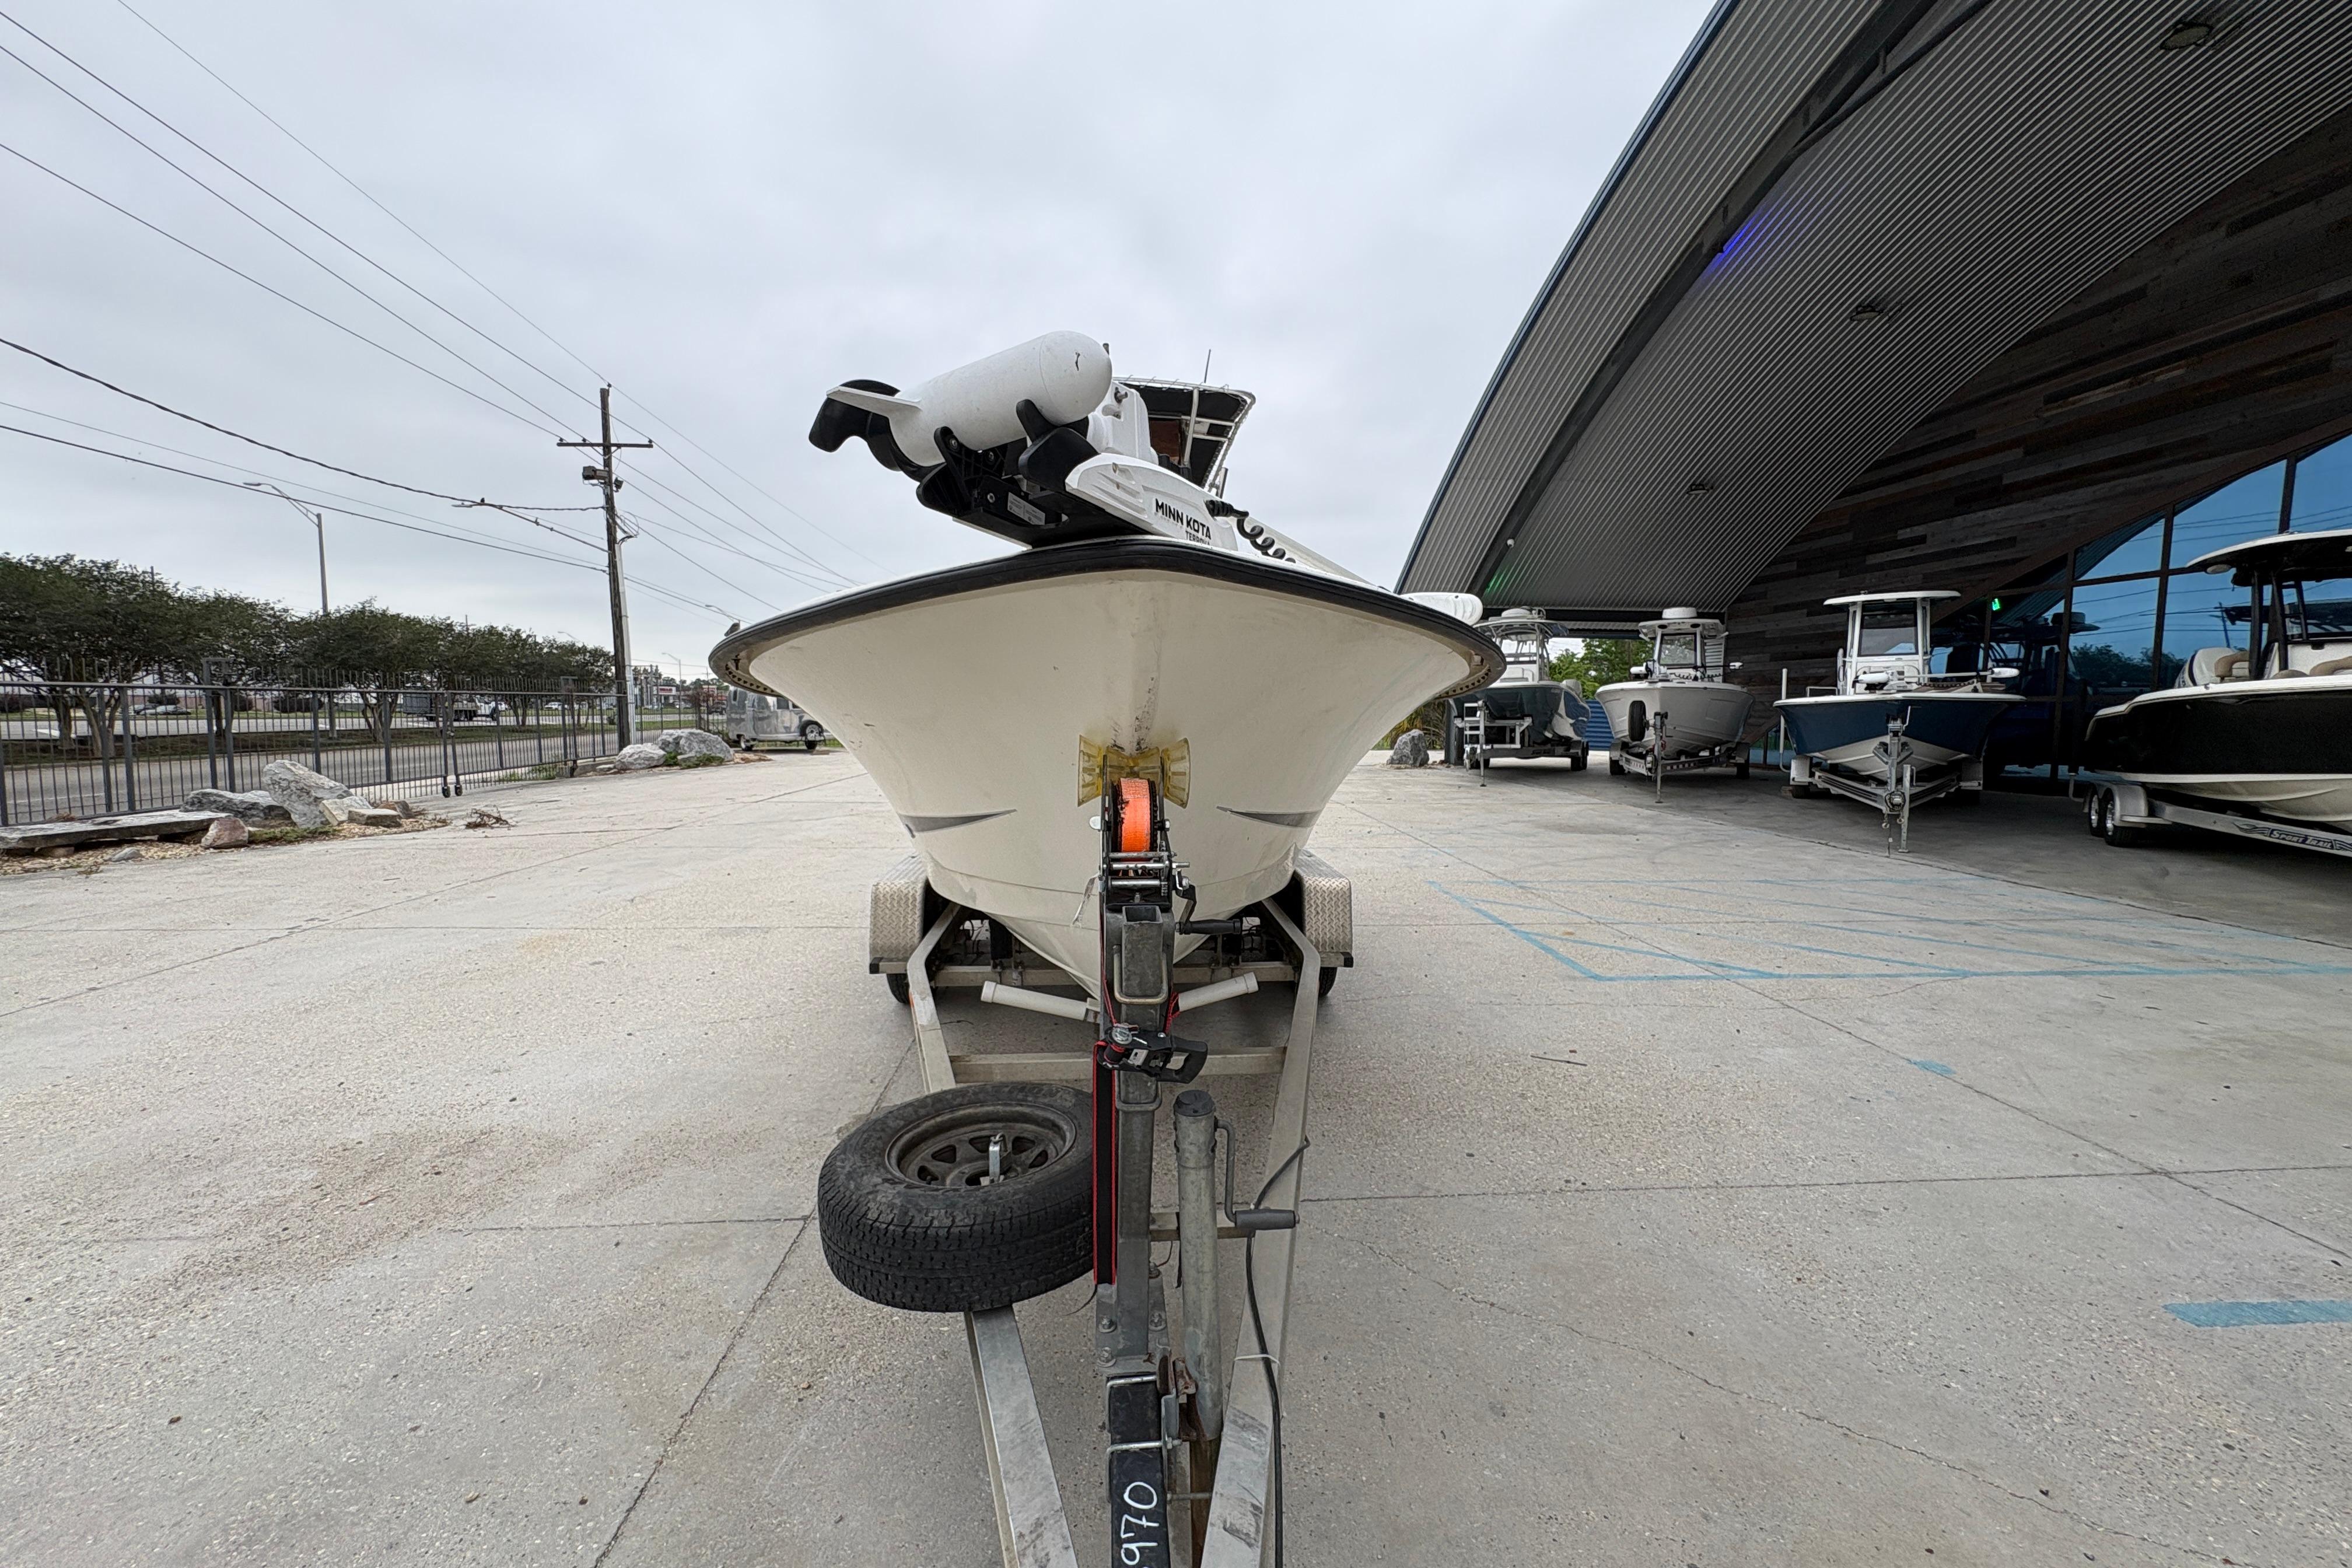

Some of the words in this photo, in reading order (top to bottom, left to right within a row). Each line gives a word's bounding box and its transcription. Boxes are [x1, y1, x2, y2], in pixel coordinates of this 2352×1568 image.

[1156, 498, 1184, 525] MINN
[1186, 514, 1211, 540] KOTA
[1121, 1482, 1160, 1568] 970
